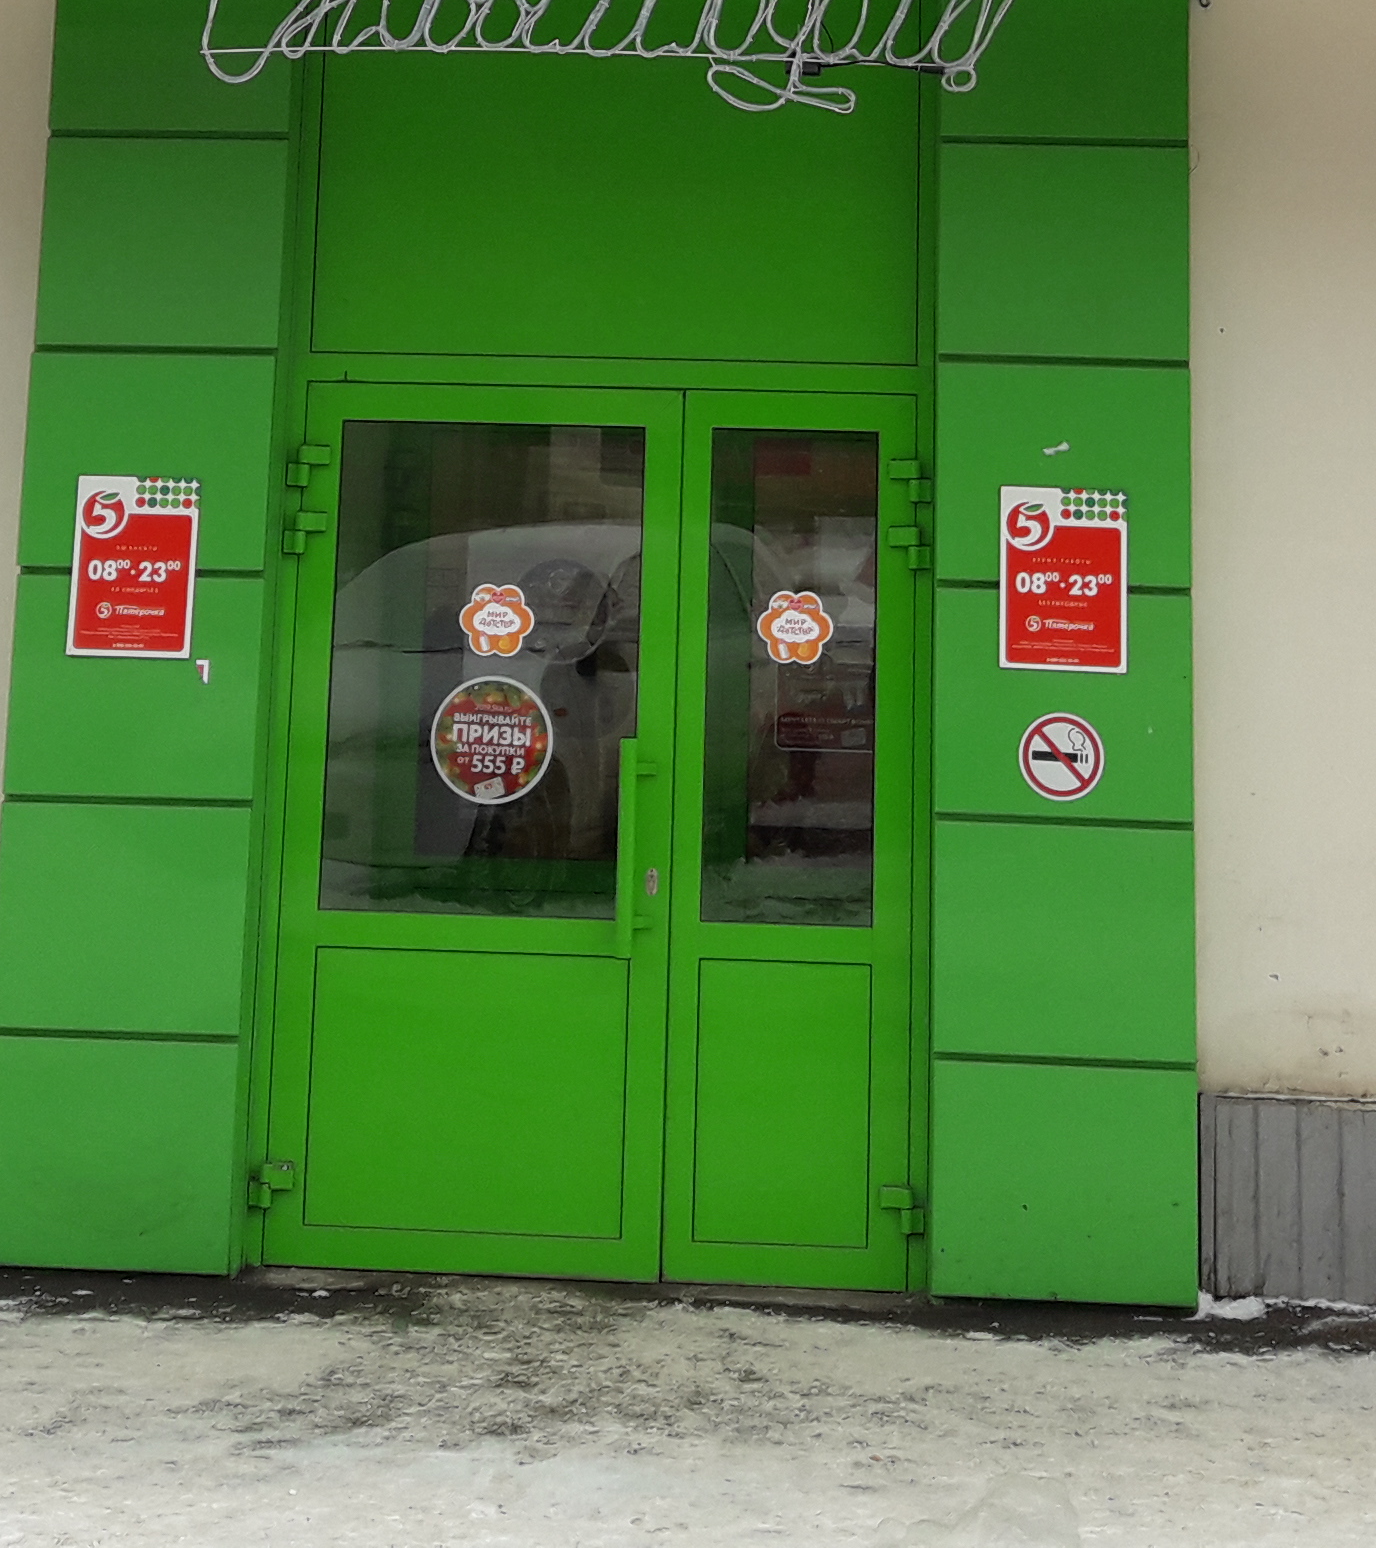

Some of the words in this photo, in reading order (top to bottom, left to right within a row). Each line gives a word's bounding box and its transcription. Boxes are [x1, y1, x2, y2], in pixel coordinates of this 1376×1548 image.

[453, 712, 532, 727] ВЫИГРЫВАЙТЕ
[452, 723, 532, 747] ПРИЗЫ
[456, 743, 470, 753] ЗА
[471, 744, 525, 756] ПОКУПКИ
[470, 754, 506, 774] 555
